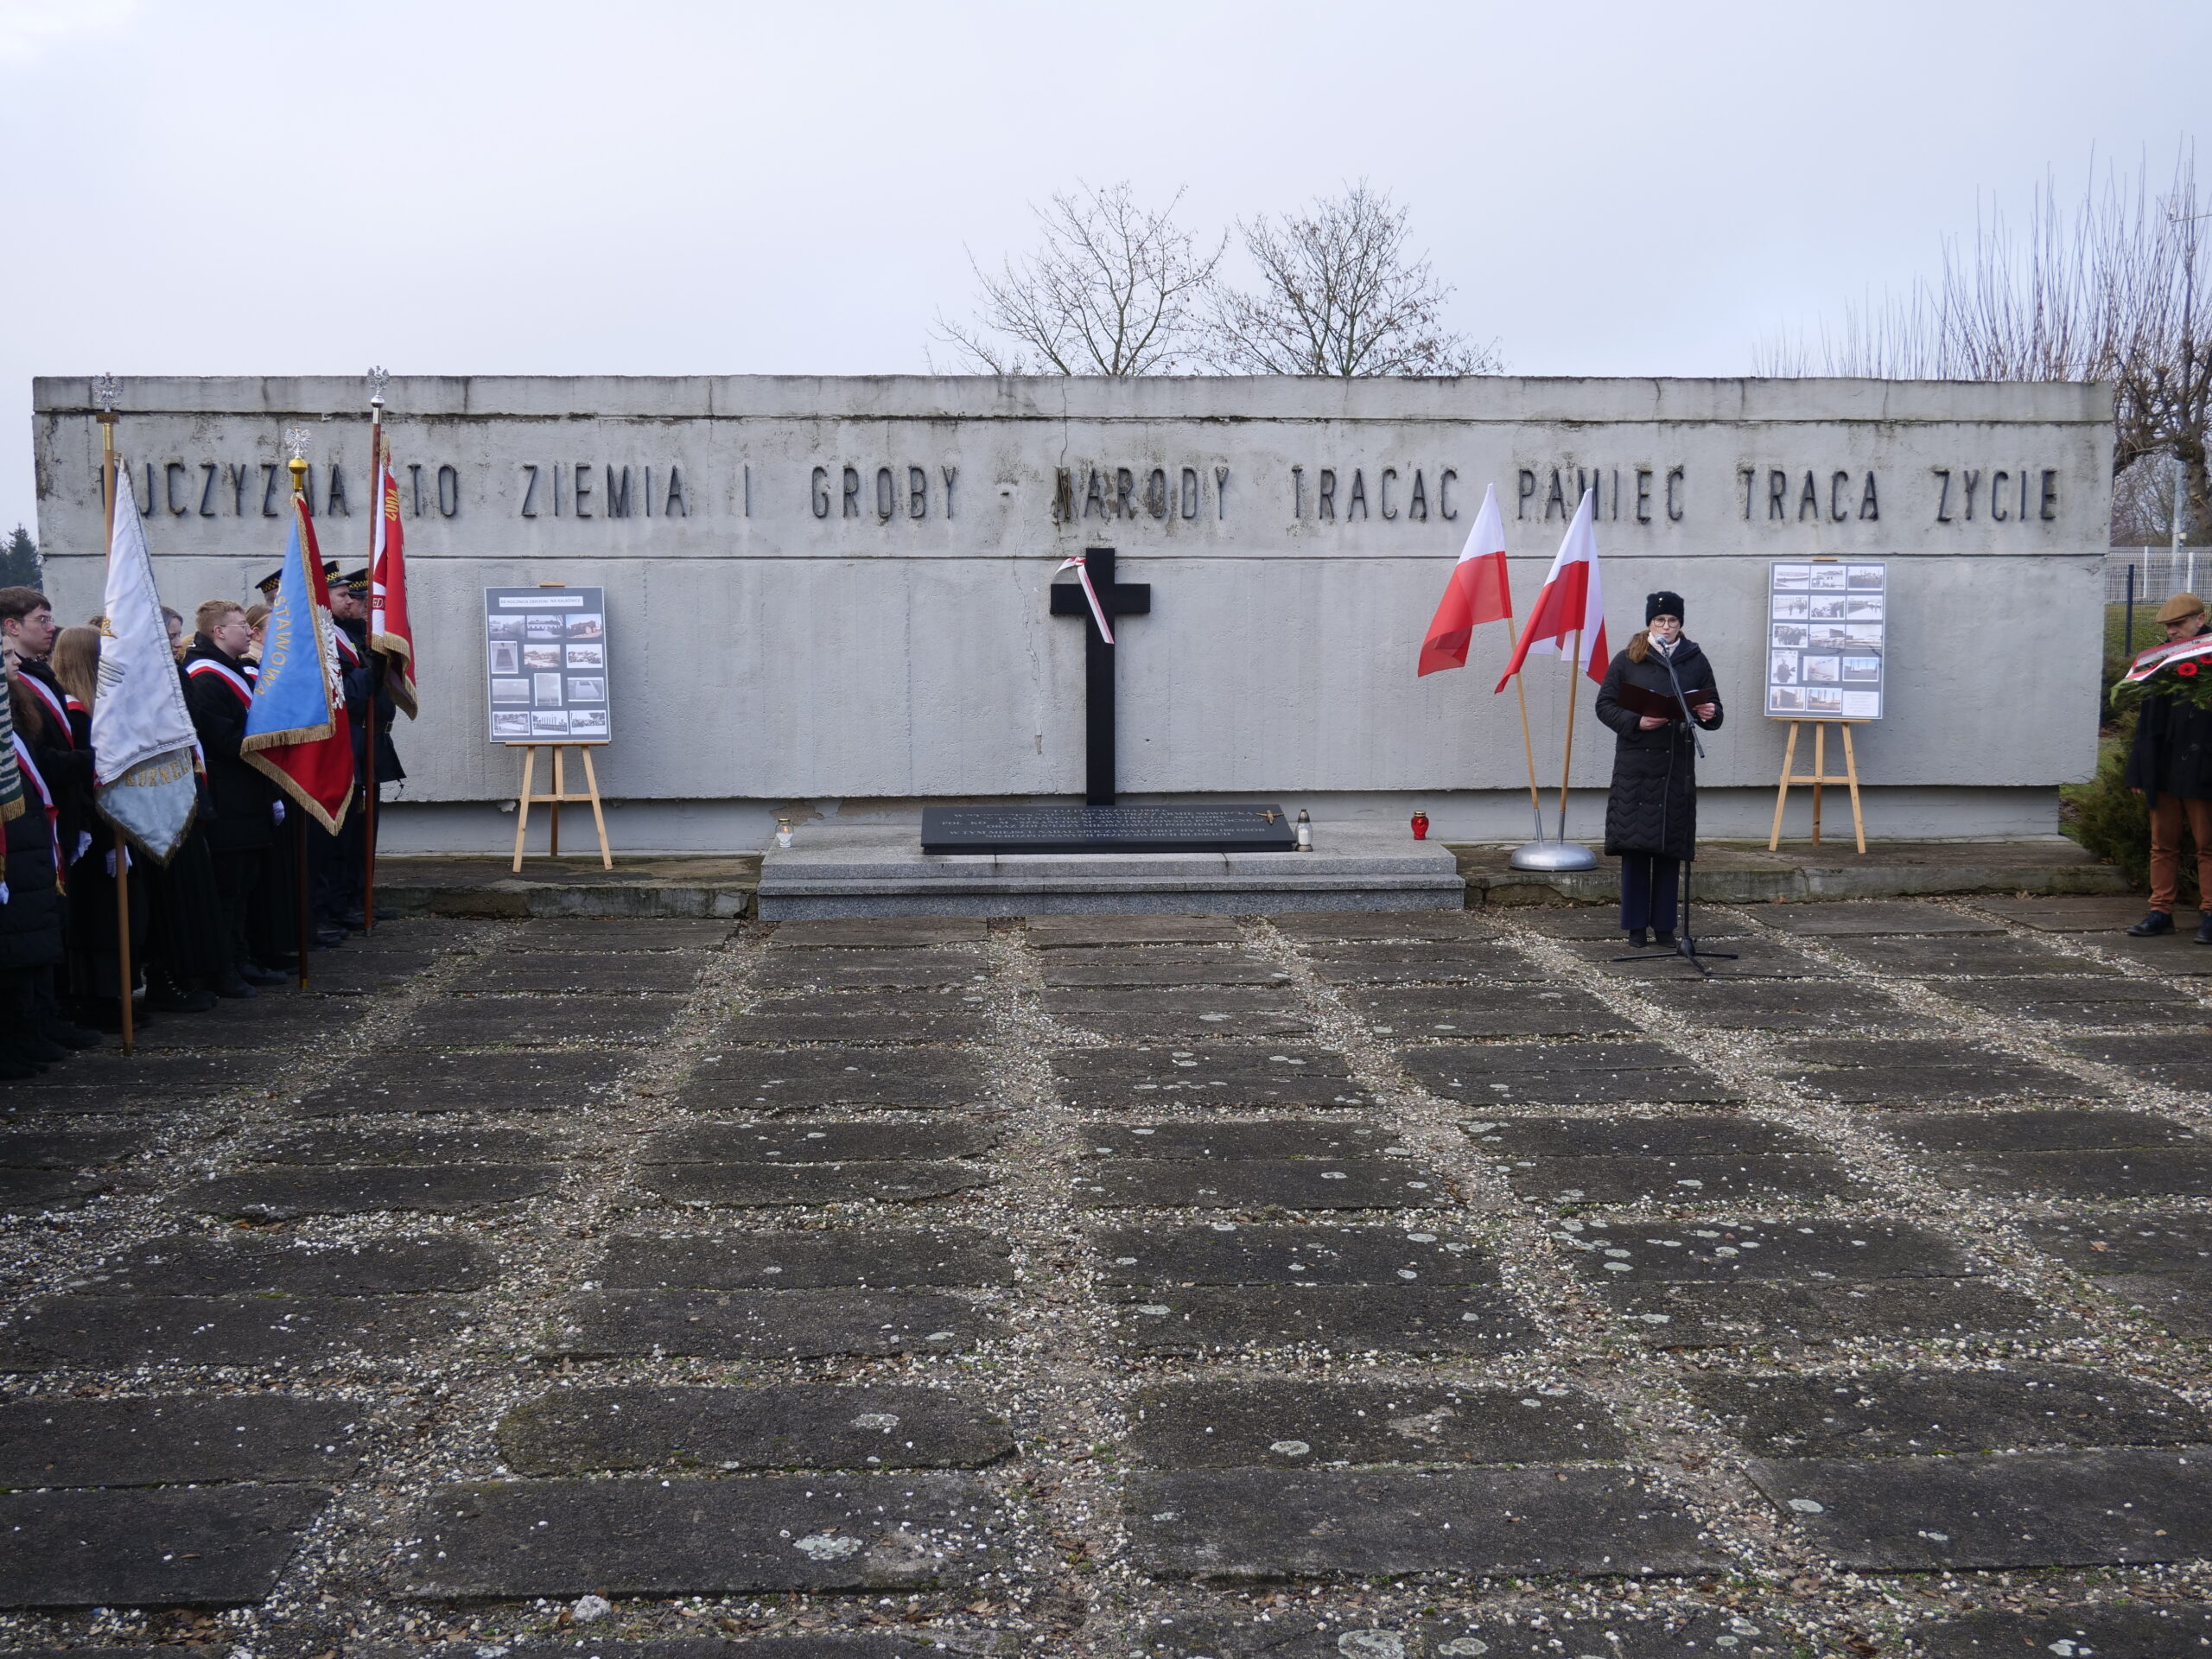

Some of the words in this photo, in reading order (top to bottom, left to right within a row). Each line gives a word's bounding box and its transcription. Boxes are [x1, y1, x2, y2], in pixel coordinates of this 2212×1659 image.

[408, 463, 457, 517] TO
[522, 463, 687, 518] ZIEMIA
[744, 464, 749, 517] I
[811, 465, 957, 518] GROBY
[1052, 465, 1230, 520] NARODY
